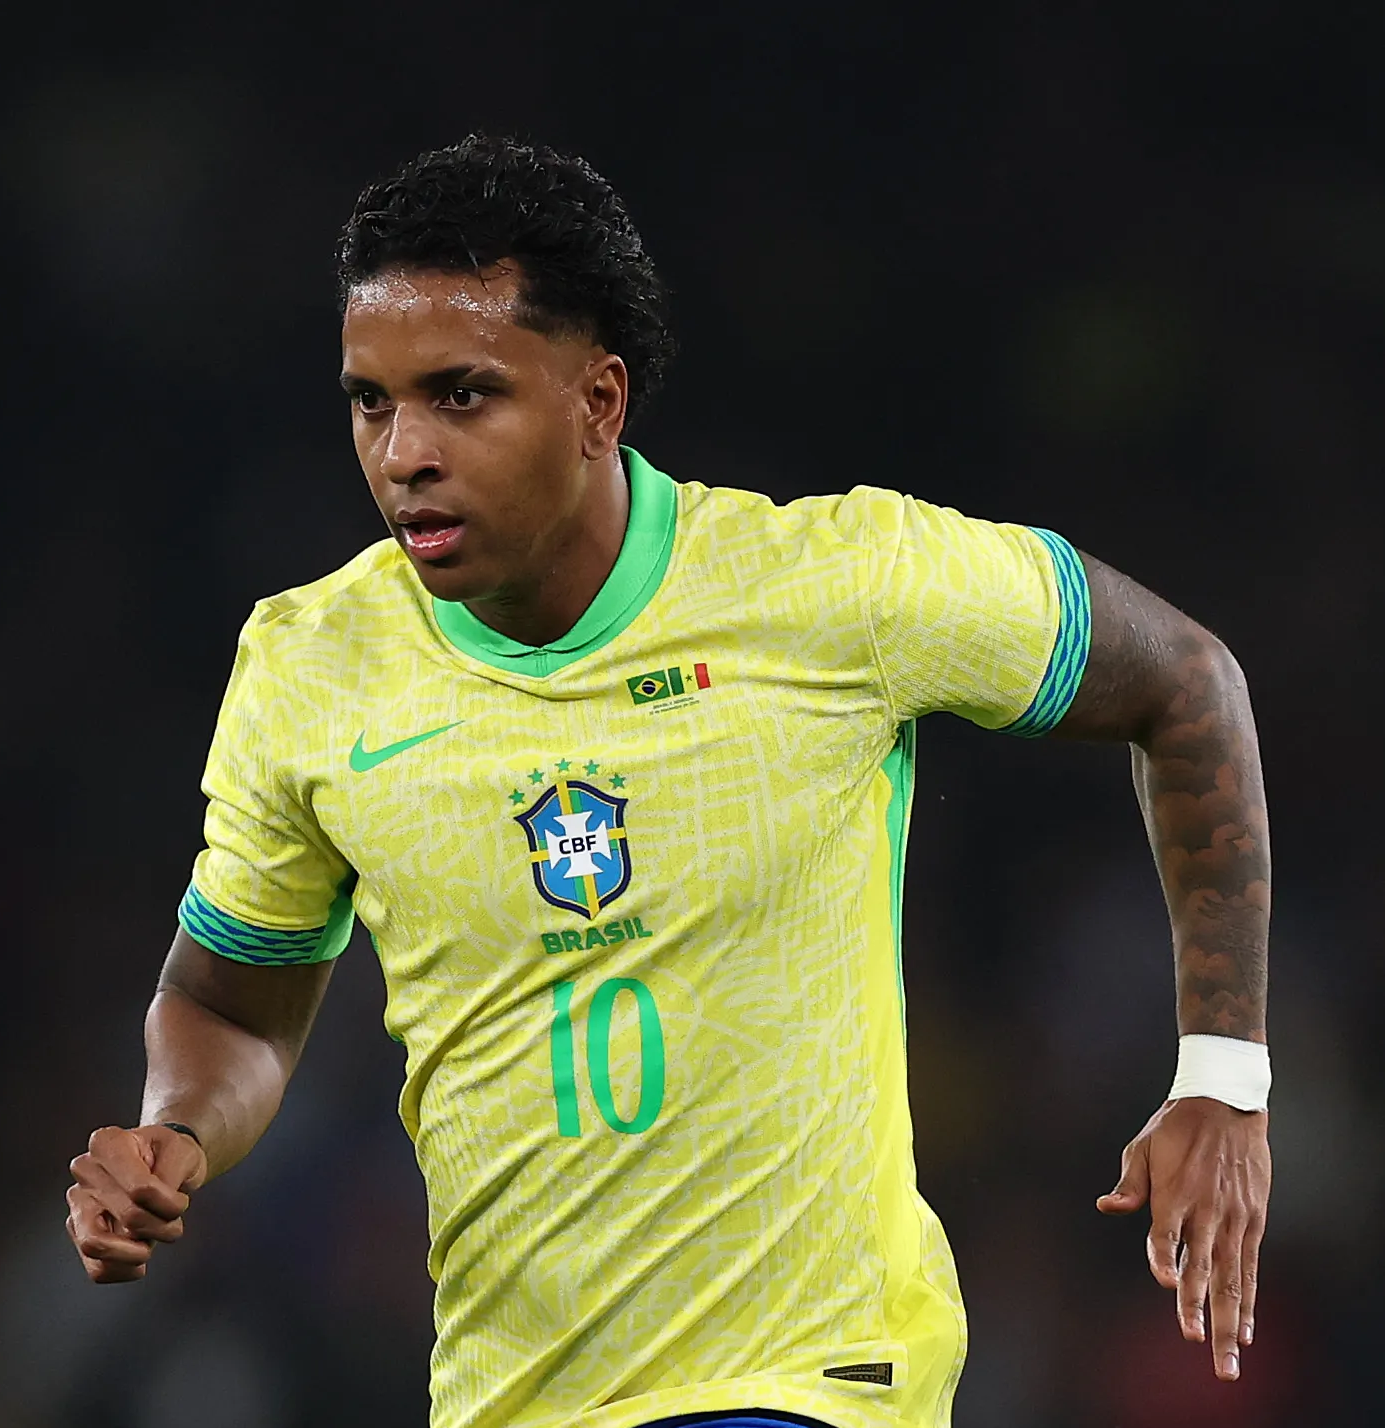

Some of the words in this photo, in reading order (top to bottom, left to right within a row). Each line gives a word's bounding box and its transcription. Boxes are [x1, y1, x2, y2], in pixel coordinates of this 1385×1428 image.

[558, 834, 597, 855] CBF
[541, 917, 653, 955] BRASIL
[550, 978, 666, 1138] 10
